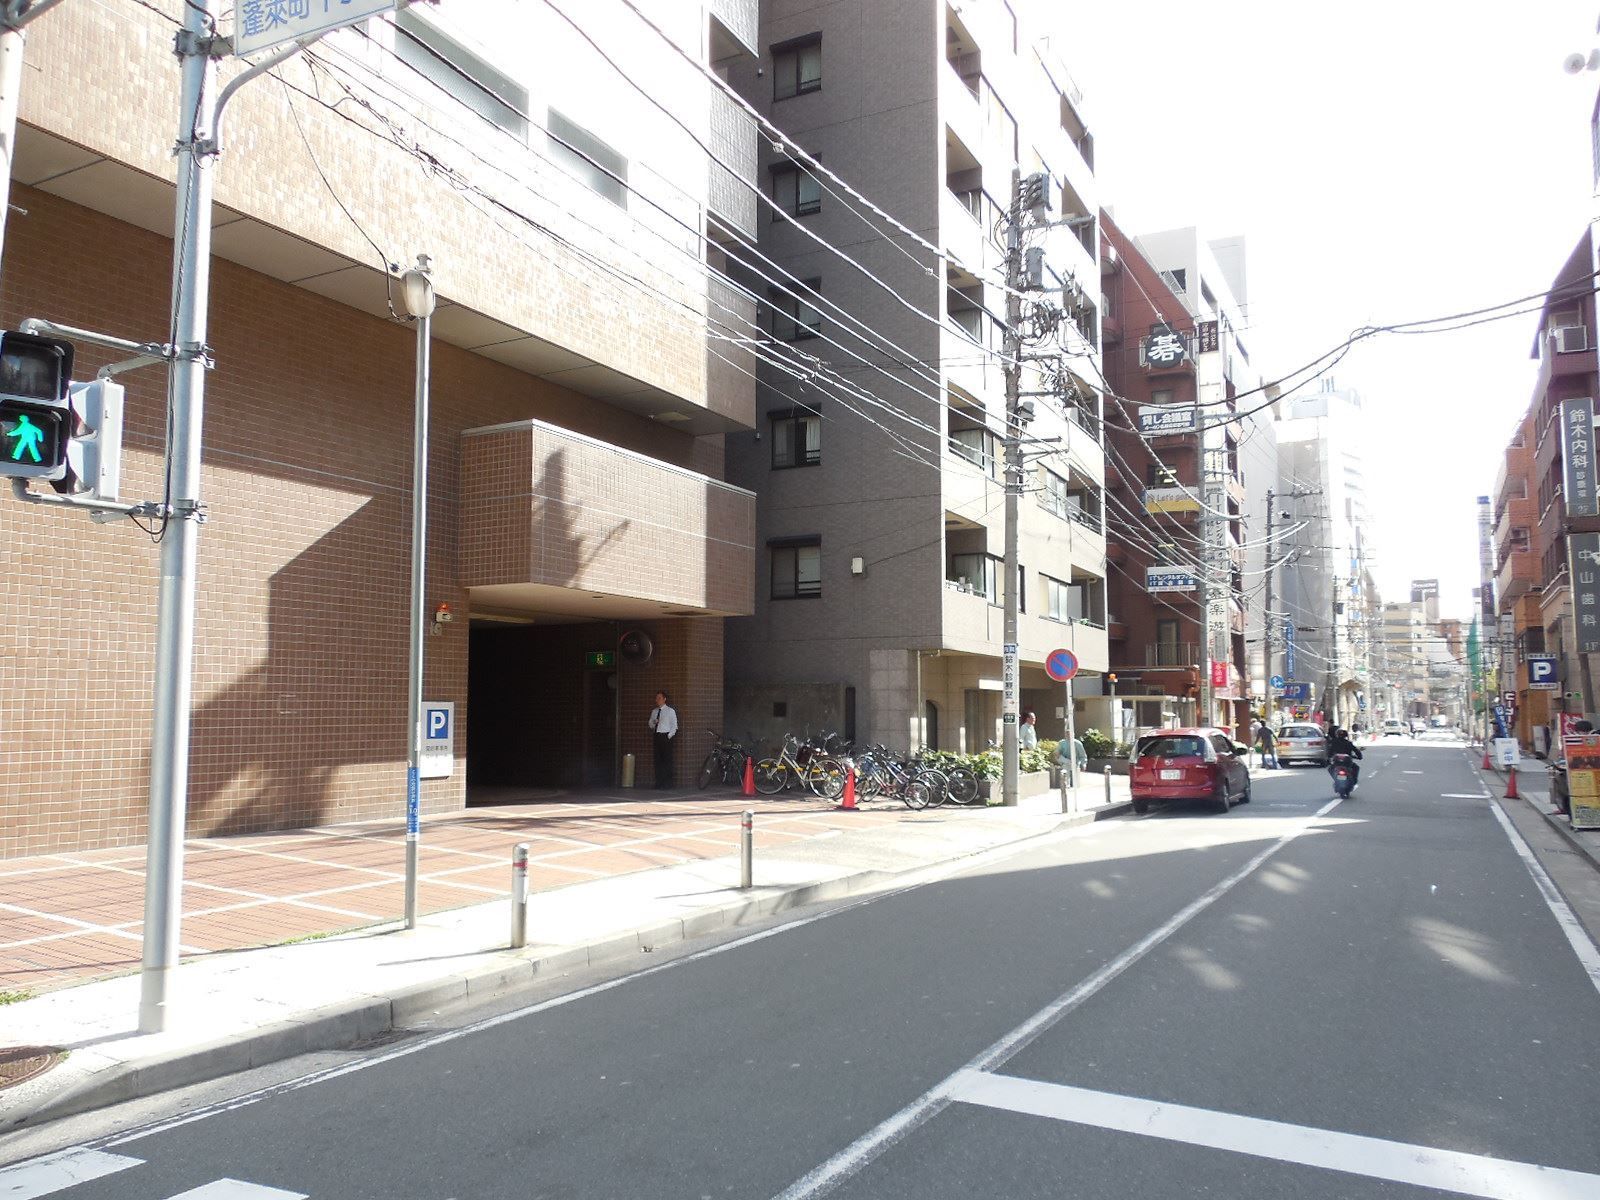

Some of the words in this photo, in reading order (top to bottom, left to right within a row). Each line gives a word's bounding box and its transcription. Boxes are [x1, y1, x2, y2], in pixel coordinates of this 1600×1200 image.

[1148, 333, 1184, 362] 碁
[1569, 409, 1589, 468] 鈴木内科
[1576, 471, 1587, 498] 診療室
[1577, 505, 1590, 515] 2F
[1578, 549, 1597, 626] 中山歯科
[1585, 642, 1598, 652] 1F
[1533, 661, 1552, 680] P
[430, 711, 446, 738] P
